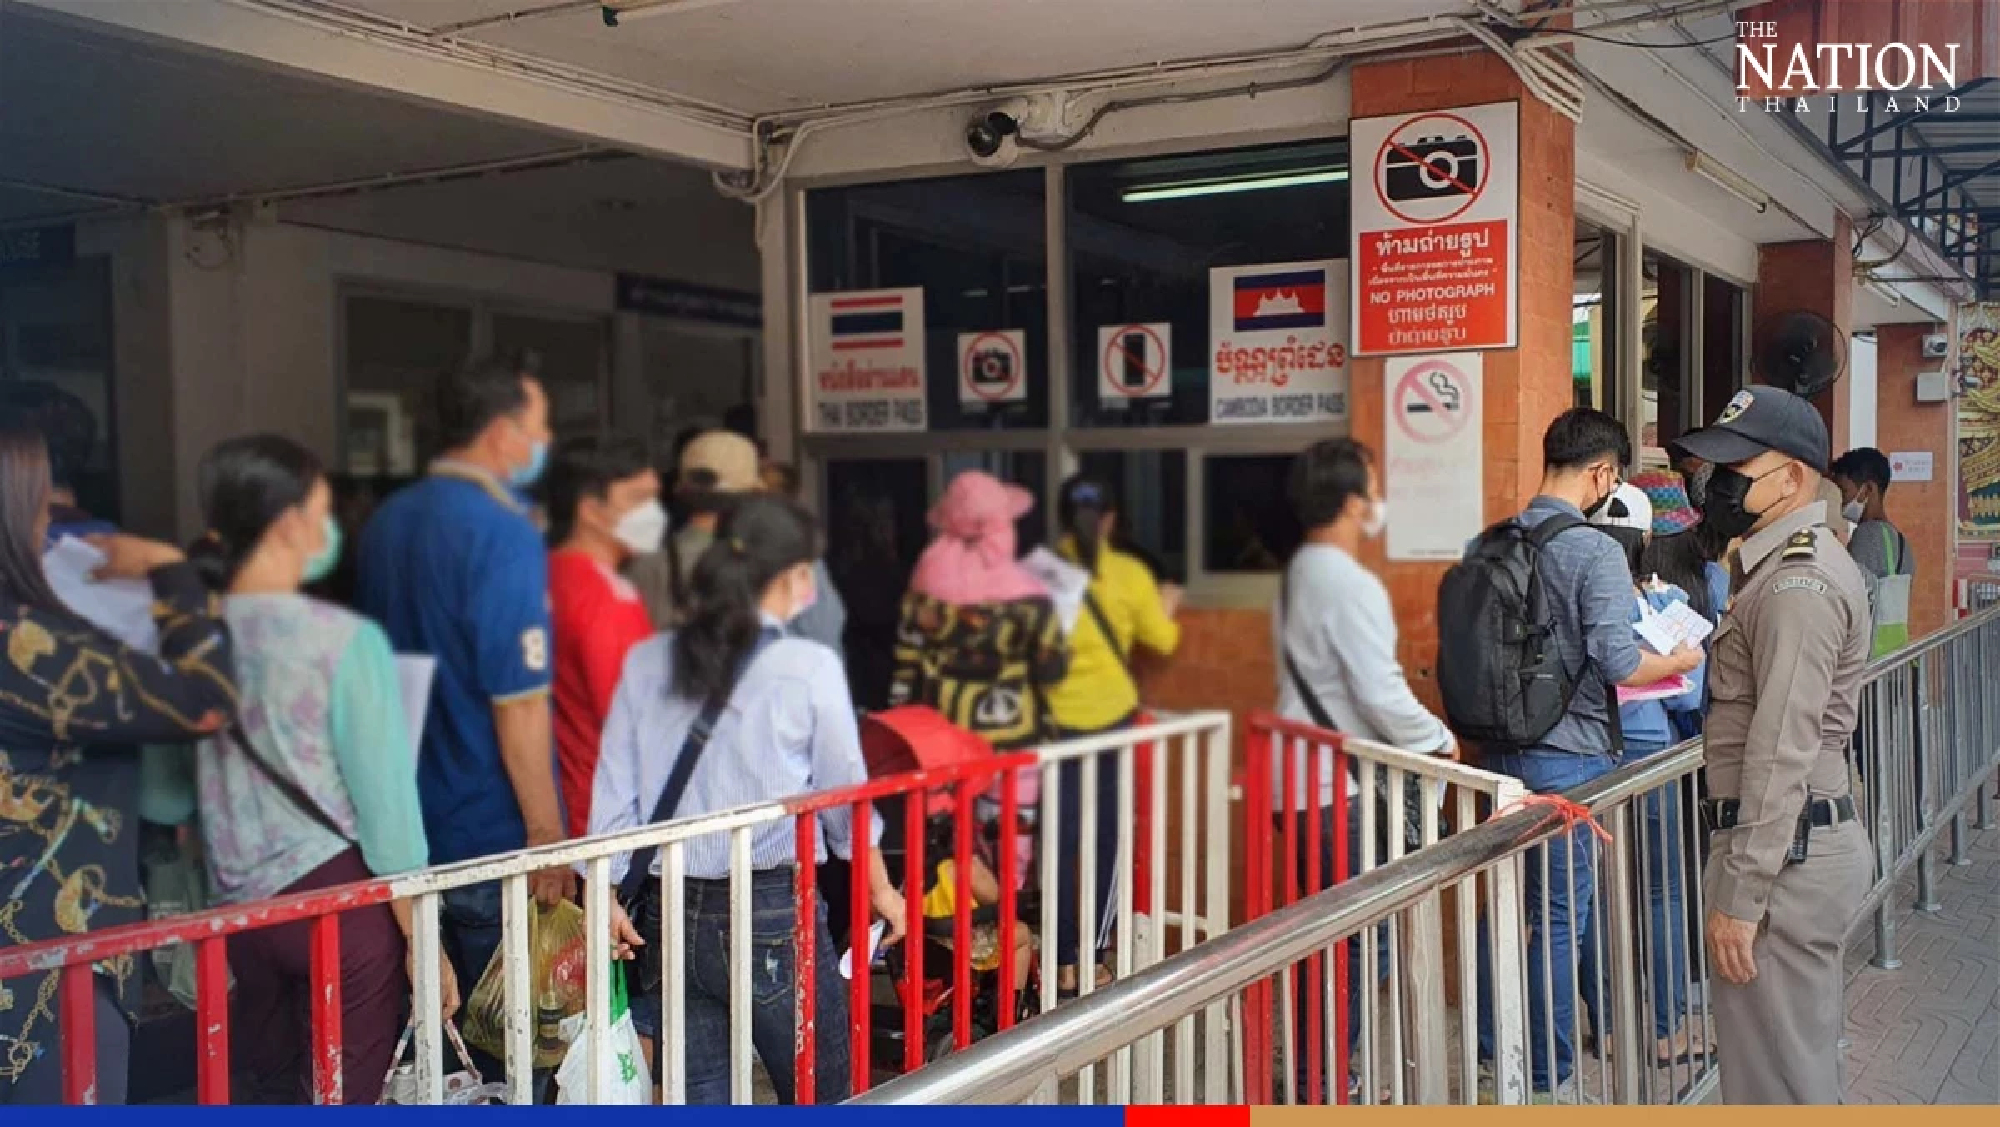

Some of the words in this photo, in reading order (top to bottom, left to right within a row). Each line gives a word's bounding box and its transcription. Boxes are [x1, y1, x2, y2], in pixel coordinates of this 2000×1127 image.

[1375, 227, 1489, 258] ห้ามถ่ายรูป
[1370, 291, 1391, 304] NO
[1396, 282, 1495, 303] PHOTOGRAPH
[846, 399, 888, 428] BORDER
[1272, 393, 1313, 418] BORDER
[1318, 392, 1345, 415] PASS
